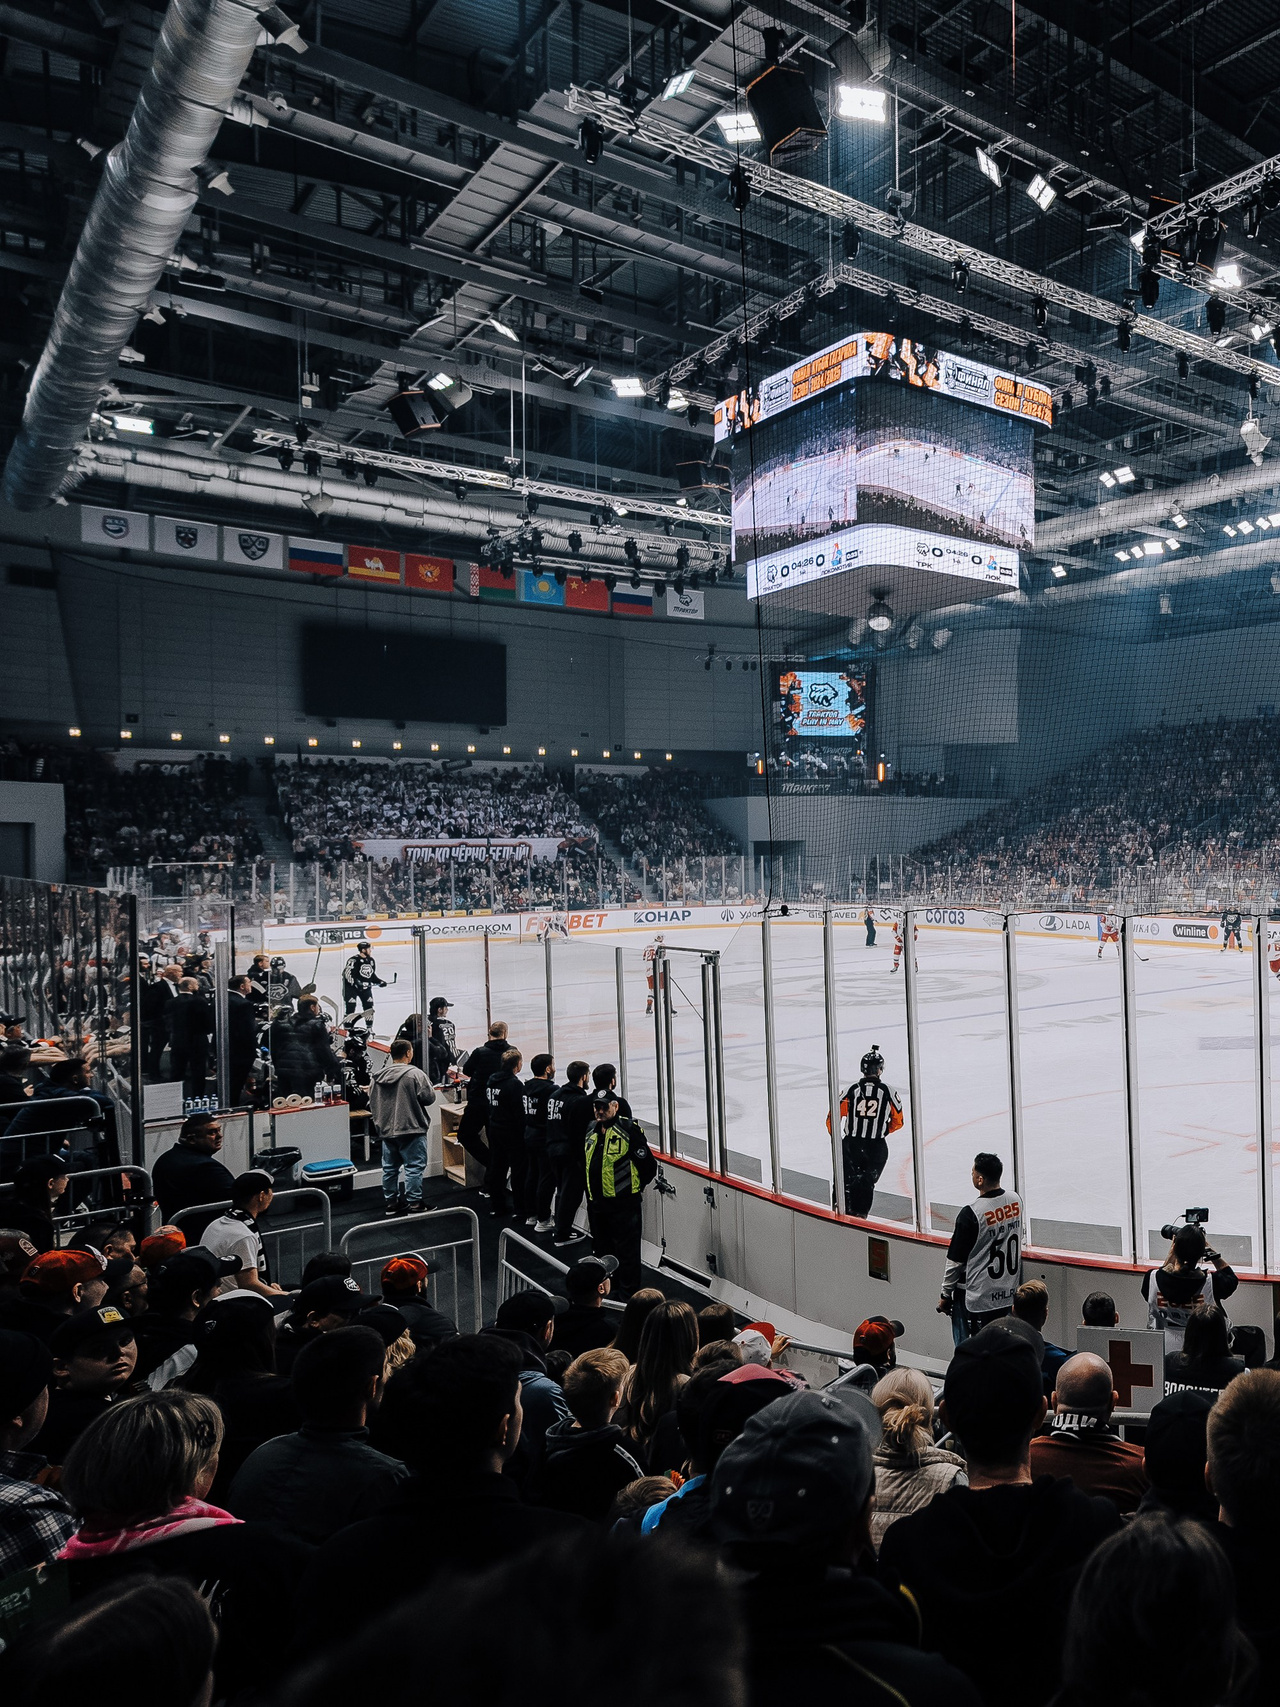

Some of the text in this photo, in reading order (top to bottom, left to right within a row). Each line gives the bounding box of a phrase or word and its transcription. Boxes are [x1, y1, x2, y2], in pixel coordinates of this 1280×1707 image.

[957, 370, 989, 391] ФИНАЛ
[994, 375, 1024, 397] ФИНЛ
[994, 391, 1021, 412] СЕЗОН
[916, 560, 933, 569] ТРК
[985, 574, 1002, 582] ЛОК
[406, 847, 450, 863] ТОЛЬКО
[633, 910, 692, 924] КОНАР
[808, 910, 857, 919] GISAVED
[423, 922, 512, 935] Ростелеком
[526, 913, 608, 932] FBET
[1065, 919, 1091, 931] LADA
[309, 929, 361, 940] Wine
[1175, 926, 1207, 937] Winline
[443, 1026, 454, 1036] 20
[857, 1100, 878, 1117] 42
[984, 1202, 1020, 1227] 2025
[987, 1234, 1019, 1280] 50
[992, 1288, 1018, 1302] KHL.R
